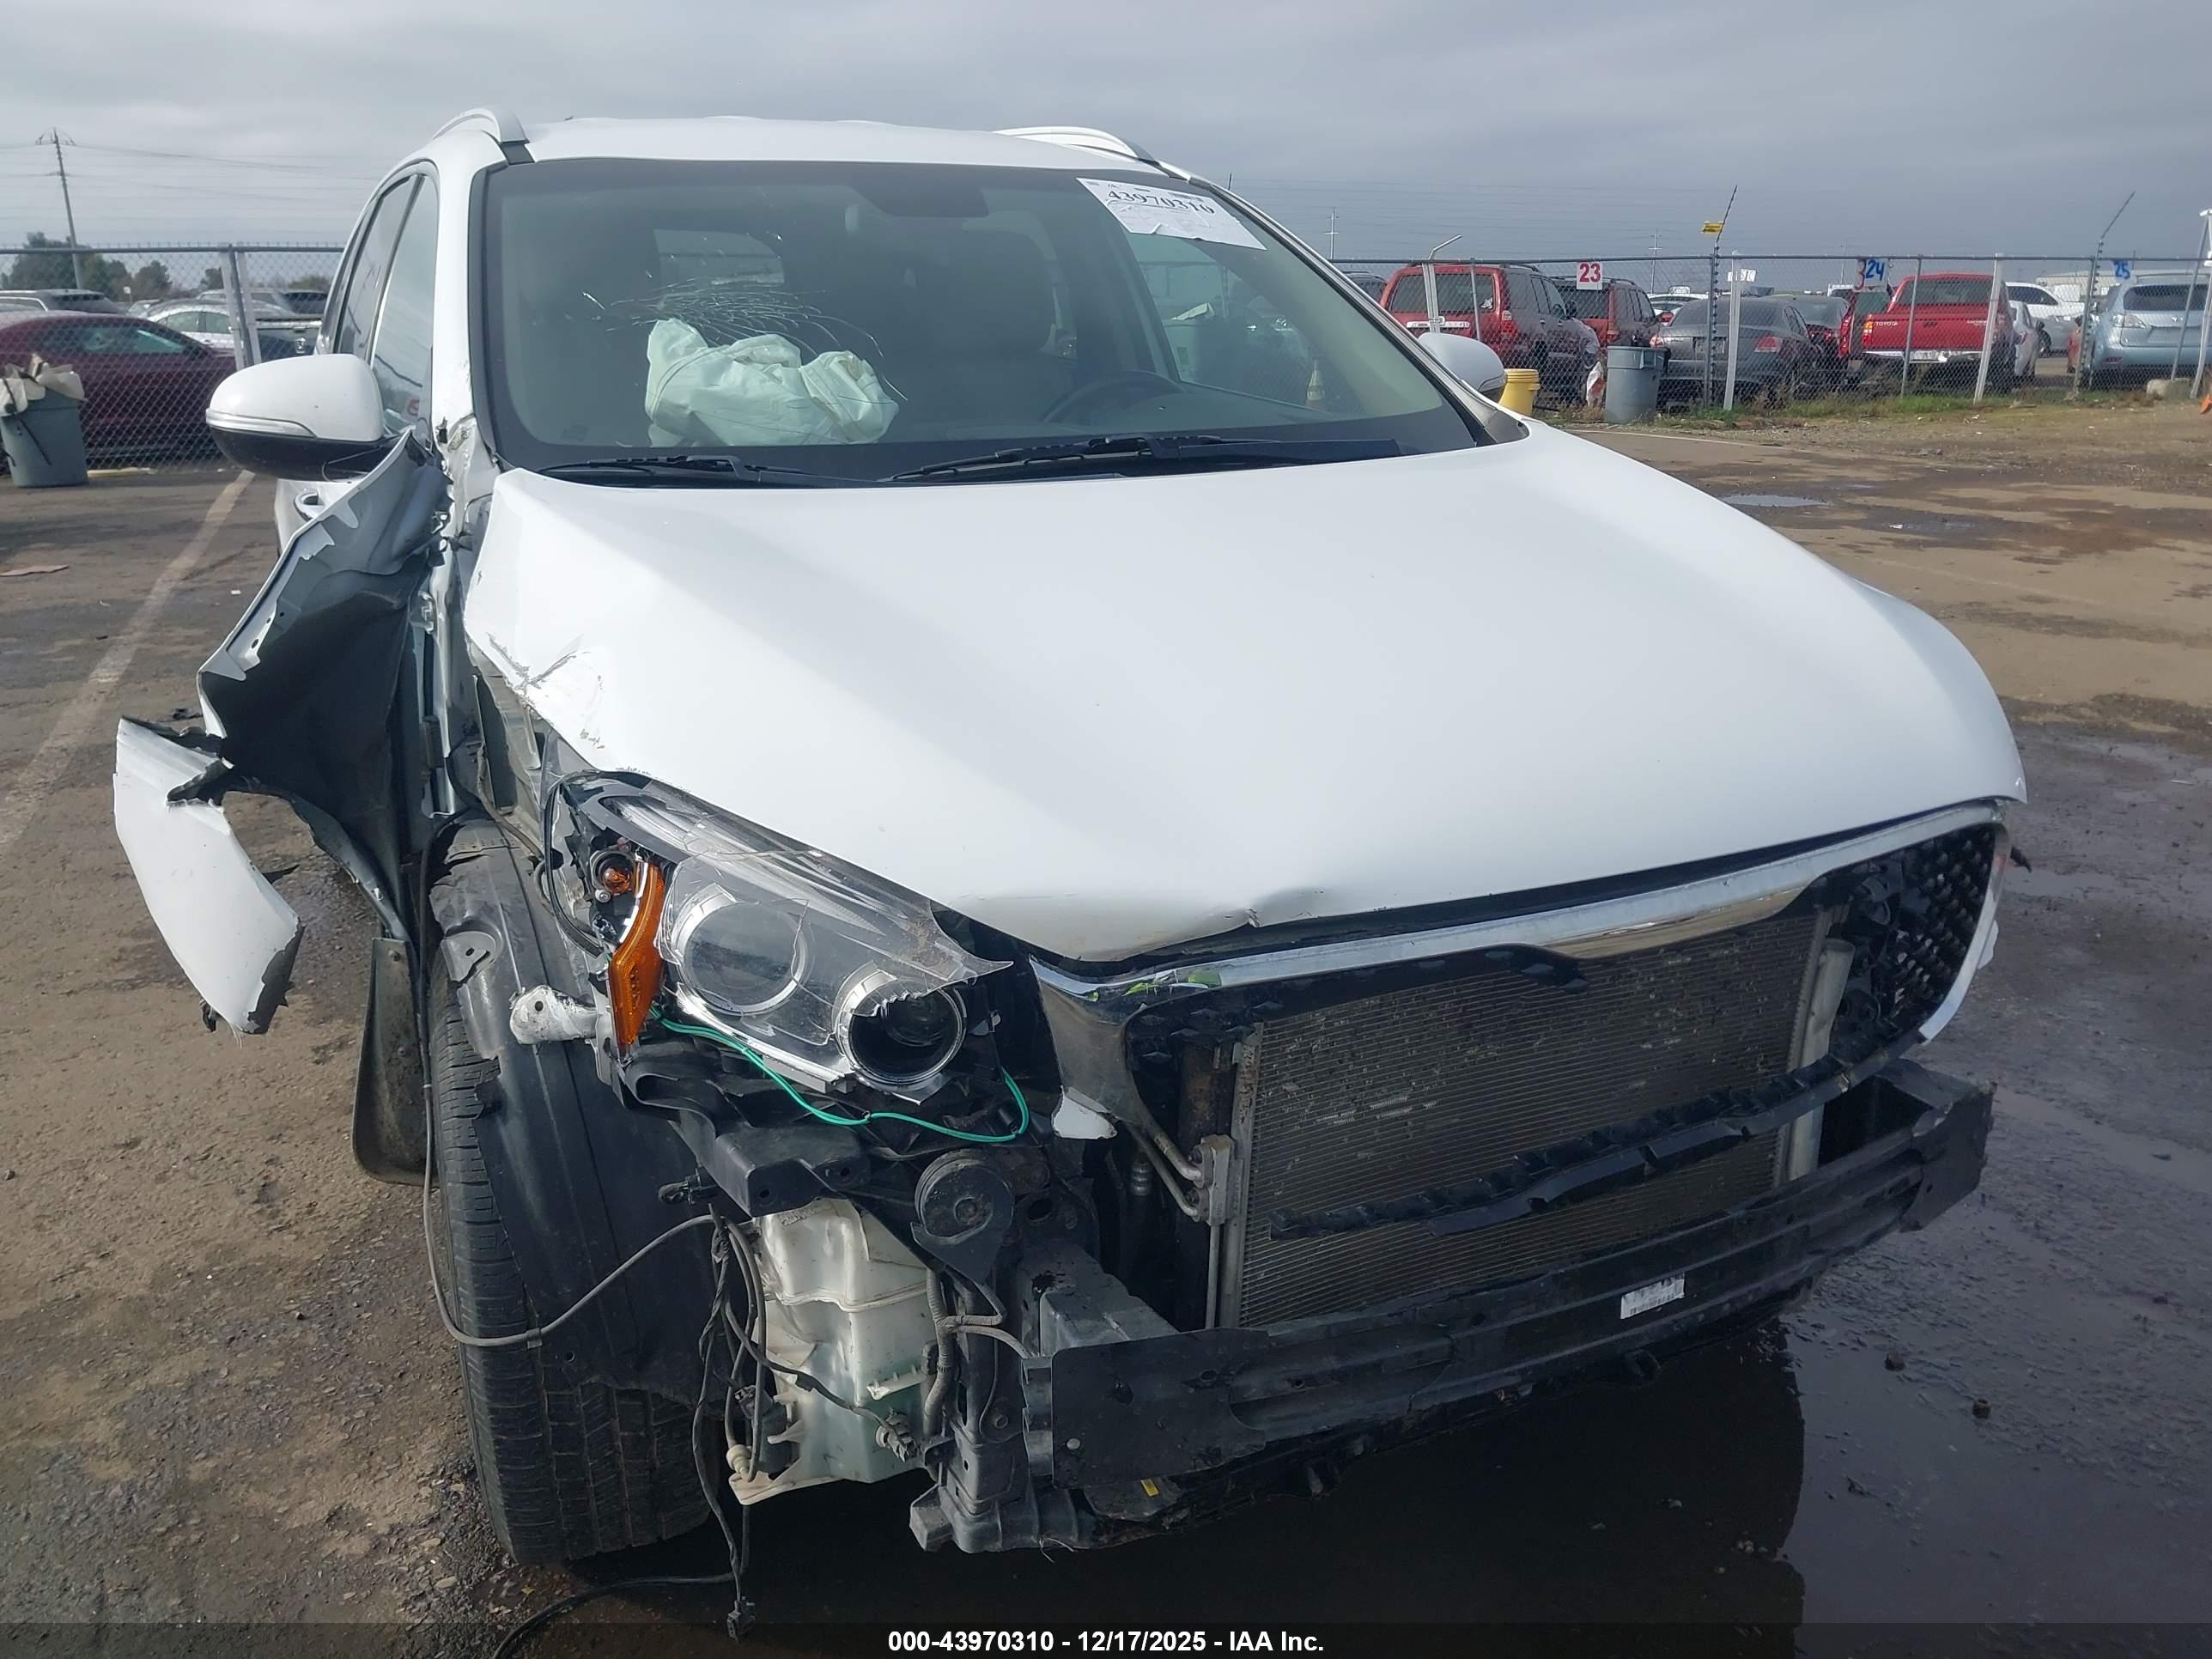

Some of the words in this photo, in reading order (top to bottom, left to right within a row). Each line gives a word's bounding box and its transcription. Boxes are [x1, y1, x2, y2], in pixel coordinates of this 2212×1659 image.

[1108, 190, 1215, 215] 43970310
[1579, 263, 1601, 283] 23
[1865, 259, 1885, 282] 24
[2114, 260, 2130, 280] 25
